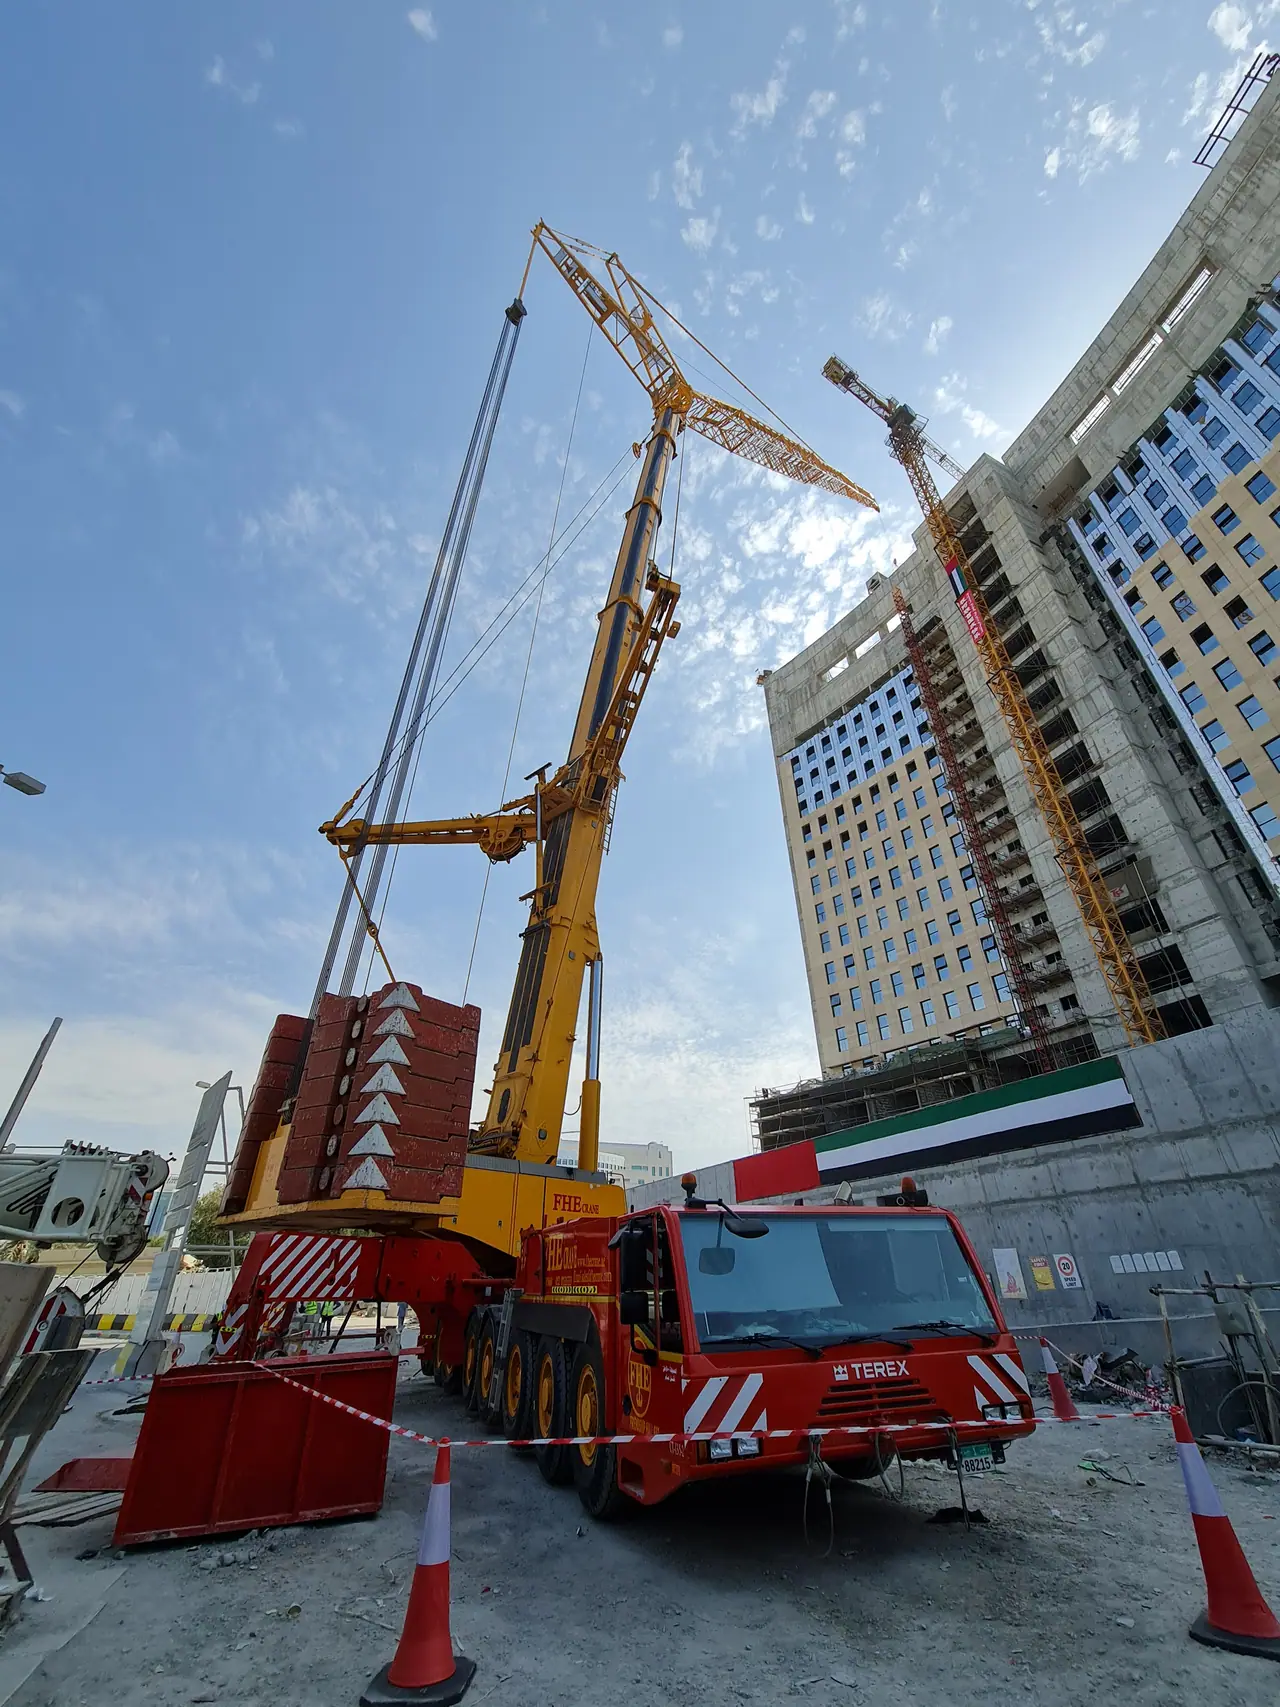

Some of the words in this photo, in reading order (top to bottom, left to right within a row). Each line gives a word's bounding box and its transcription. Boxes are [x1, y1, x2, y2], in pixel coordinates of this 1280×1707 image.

[553, 1194, 581, 1213] FHE
[582, 1203, 599, 1215] CRANE
[1062, 1262, 1070, 1270] 20
[630, 1361, 651, 1392] FHE
[851, 1360, 910, 1379] TEREX
[964, 1457, 991, 1472] 88215
